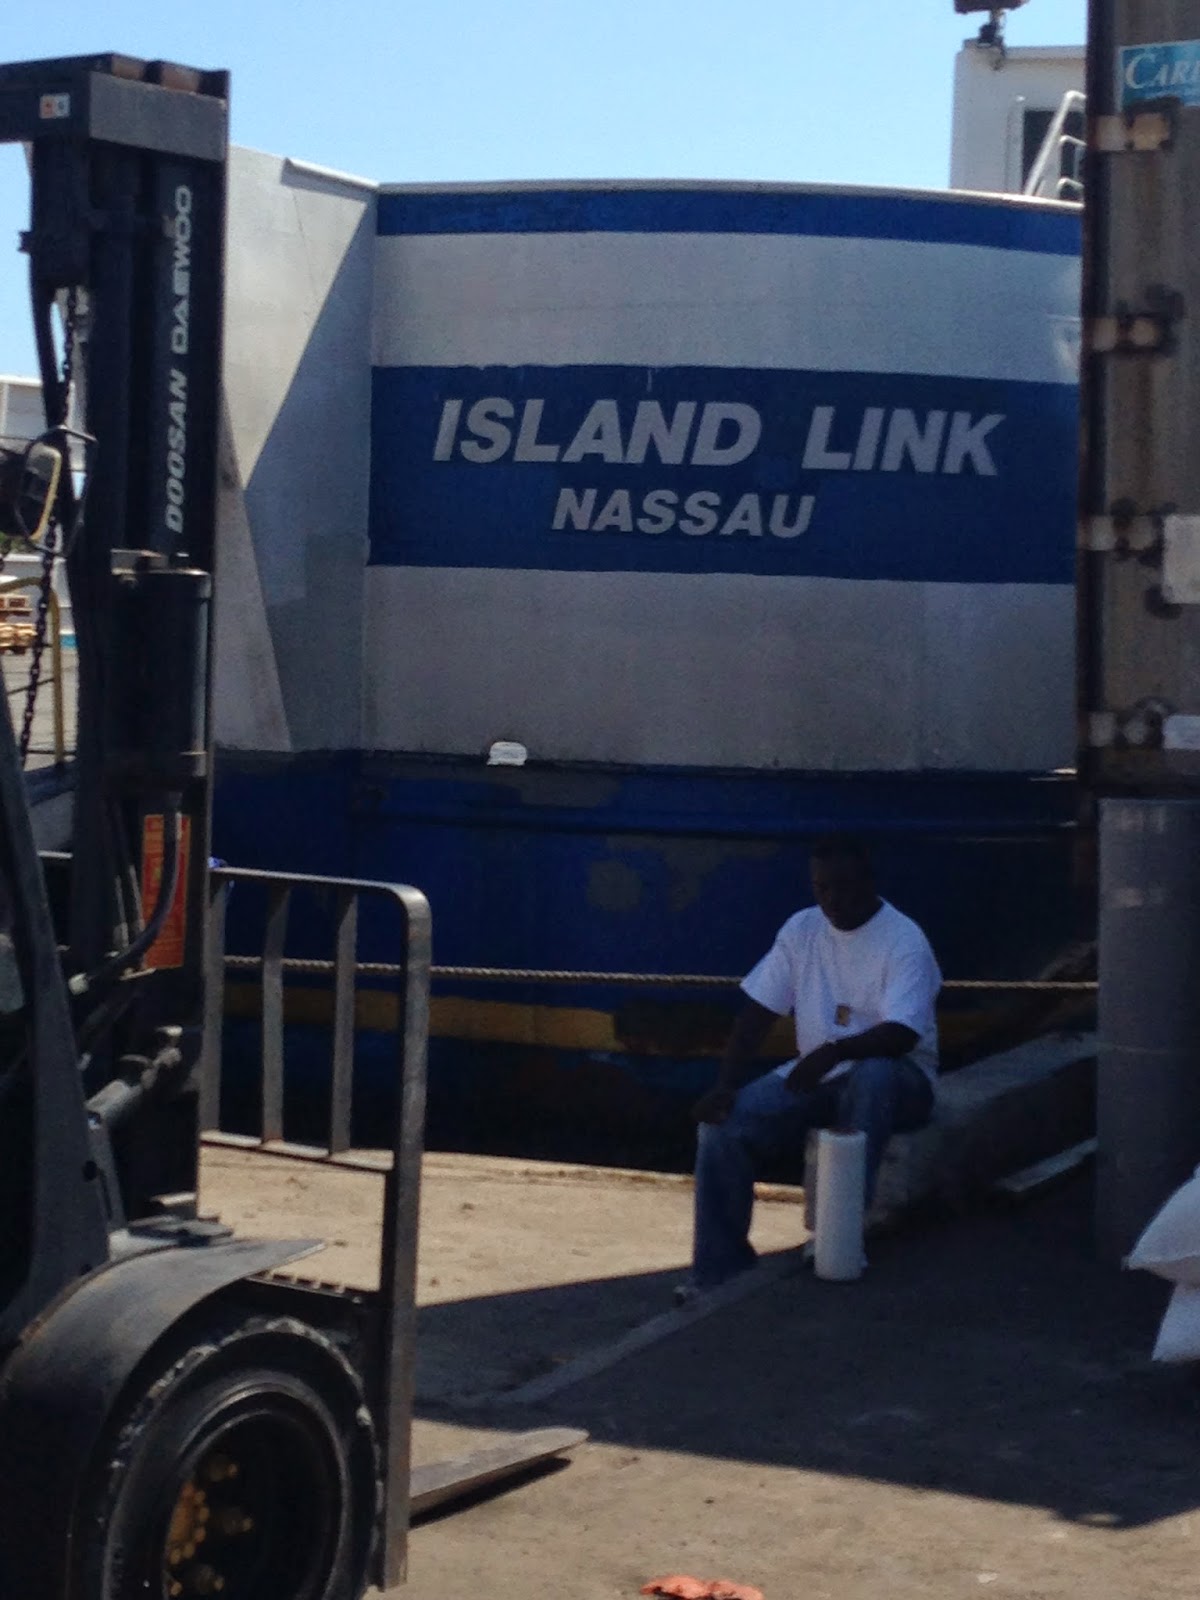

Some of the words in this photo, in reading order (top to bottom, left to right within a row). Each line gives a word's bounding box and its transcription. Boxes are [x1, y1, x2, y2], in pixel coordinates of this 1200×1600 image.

[171, 186, 192, 354] DAEWOO
[166, 370, 187, 533] DOOSAN
[433, 398, 762, 466] ISLAND
[802, 405, 1006, 476] LINK
[552, 488, 815, 538] NASSAU
